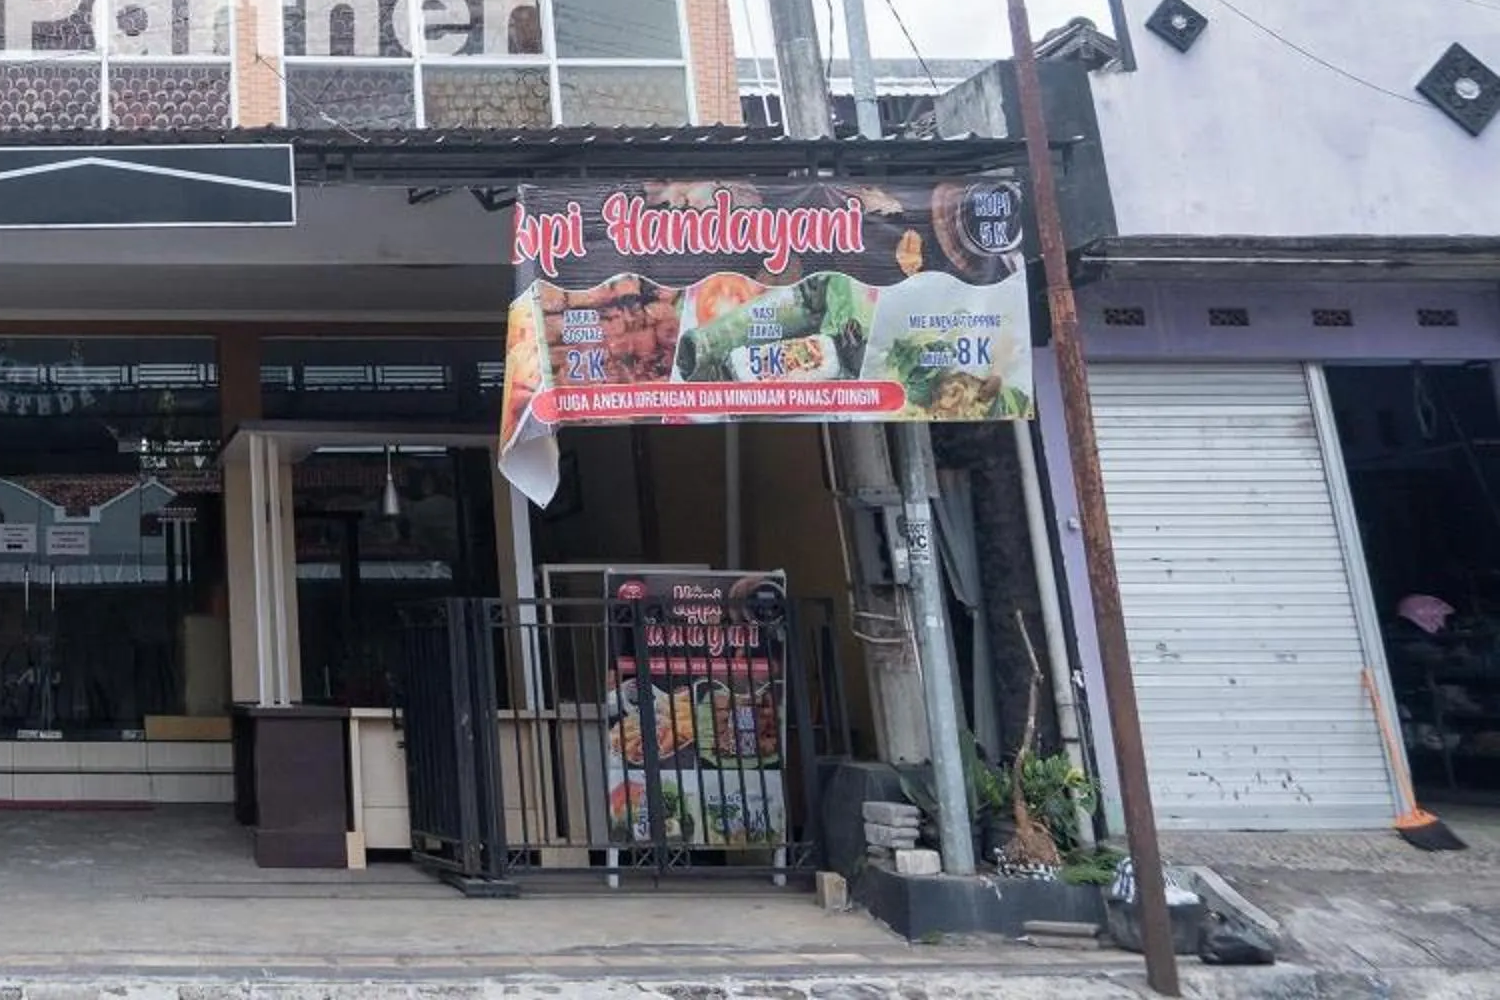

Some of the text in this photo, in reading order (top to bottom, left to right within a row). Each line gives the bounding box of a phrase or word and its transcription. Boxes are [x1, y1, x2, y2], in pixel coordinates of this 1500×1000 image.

[602, 189, 865, 275] Handayani
[555, 393, 589, 412] JUGA
[724, 388, 785, 407] MINUMAN
